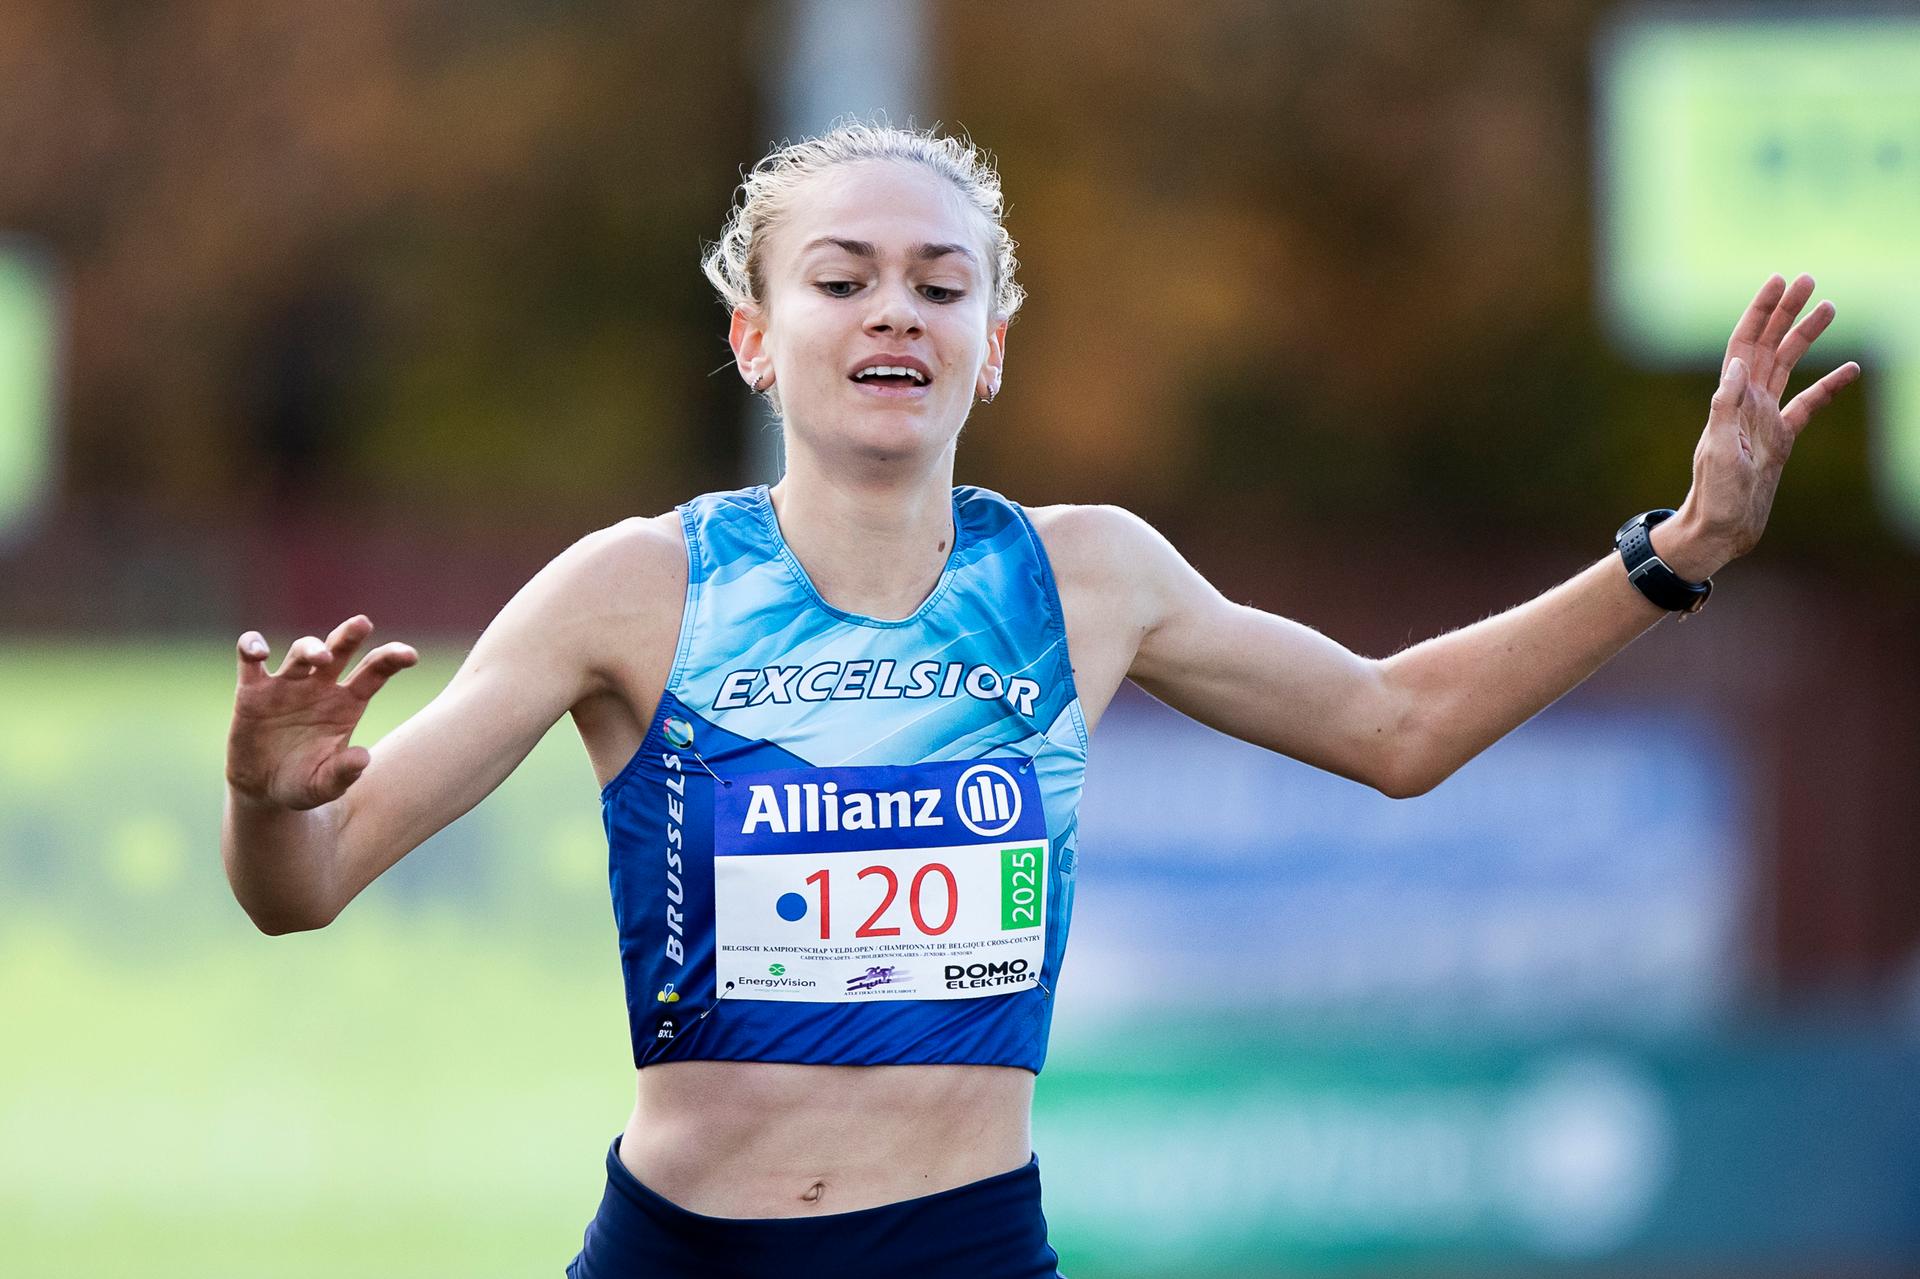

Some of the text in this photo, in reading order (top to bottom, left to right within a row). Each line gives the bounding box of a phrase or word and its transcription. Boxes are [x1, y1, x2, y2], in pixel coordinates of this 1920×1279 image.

[712, 659, 1041, 718] EXCELSIOR
[741, 782, 943, 834] Allianz
[662, 753, 686, 966] BRUSSELS
[805, 863, 958, 939] 120
[1012, 852, 1036, 922] 2025
[763, 946, 828, 954] KAMPIOENSCHAP
[829, 946, 874, 954] VELDLOPEN
[879, 943, 934, 952] CHAMPIONNAT
[949, 941, 986, 950] BELGIQUE
[987, 934, 1041, 946] CROSS-COUNTRY
[738, 976, 816, 987] EnergyVision
[945, 959, 1028, 980] DOMO
[946, 973, 1027, 989] ELEKTRO
[658, 1029, 674, 1038] BXL
